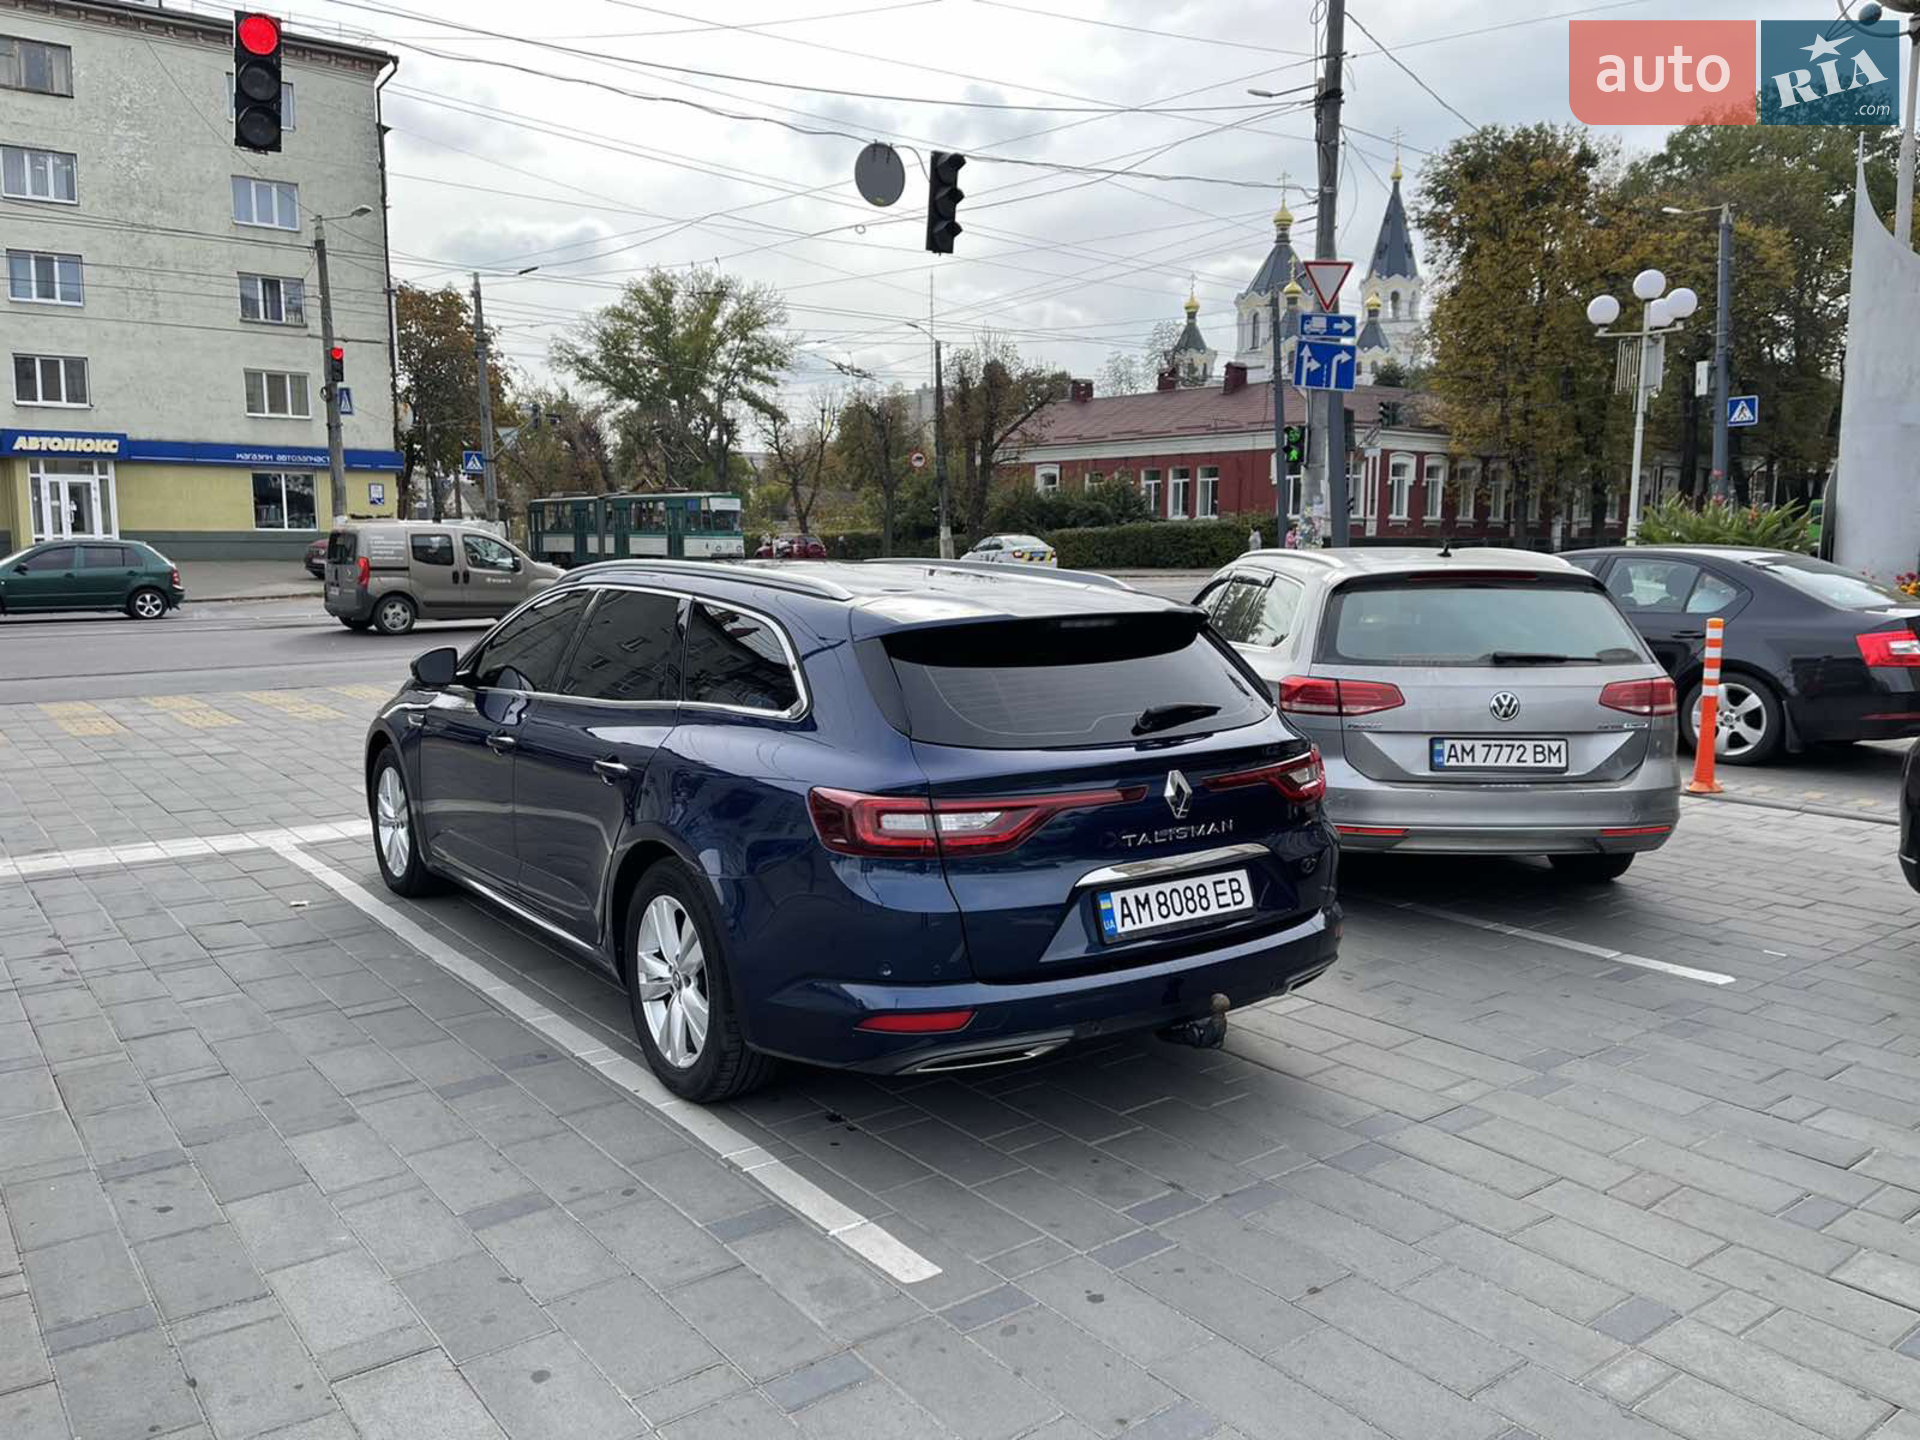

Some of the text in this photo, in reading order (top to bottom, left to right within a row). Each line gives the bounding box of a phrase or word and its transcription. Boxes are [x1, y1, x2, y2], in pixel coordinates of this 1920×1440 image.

[12, 436, 119, 453] АВТОЛЮКС
[276, 454, 330, 463] автозапчаст
[1446, 743, 1475, 763] AM
[1481, 743, 1527, 764] 7772
[1533, 744, 1562, 764] BM
[1121, 819, 1234, 847] TALISMAN
[1103, 877, 1245, 931] UA AM 8088 EB
